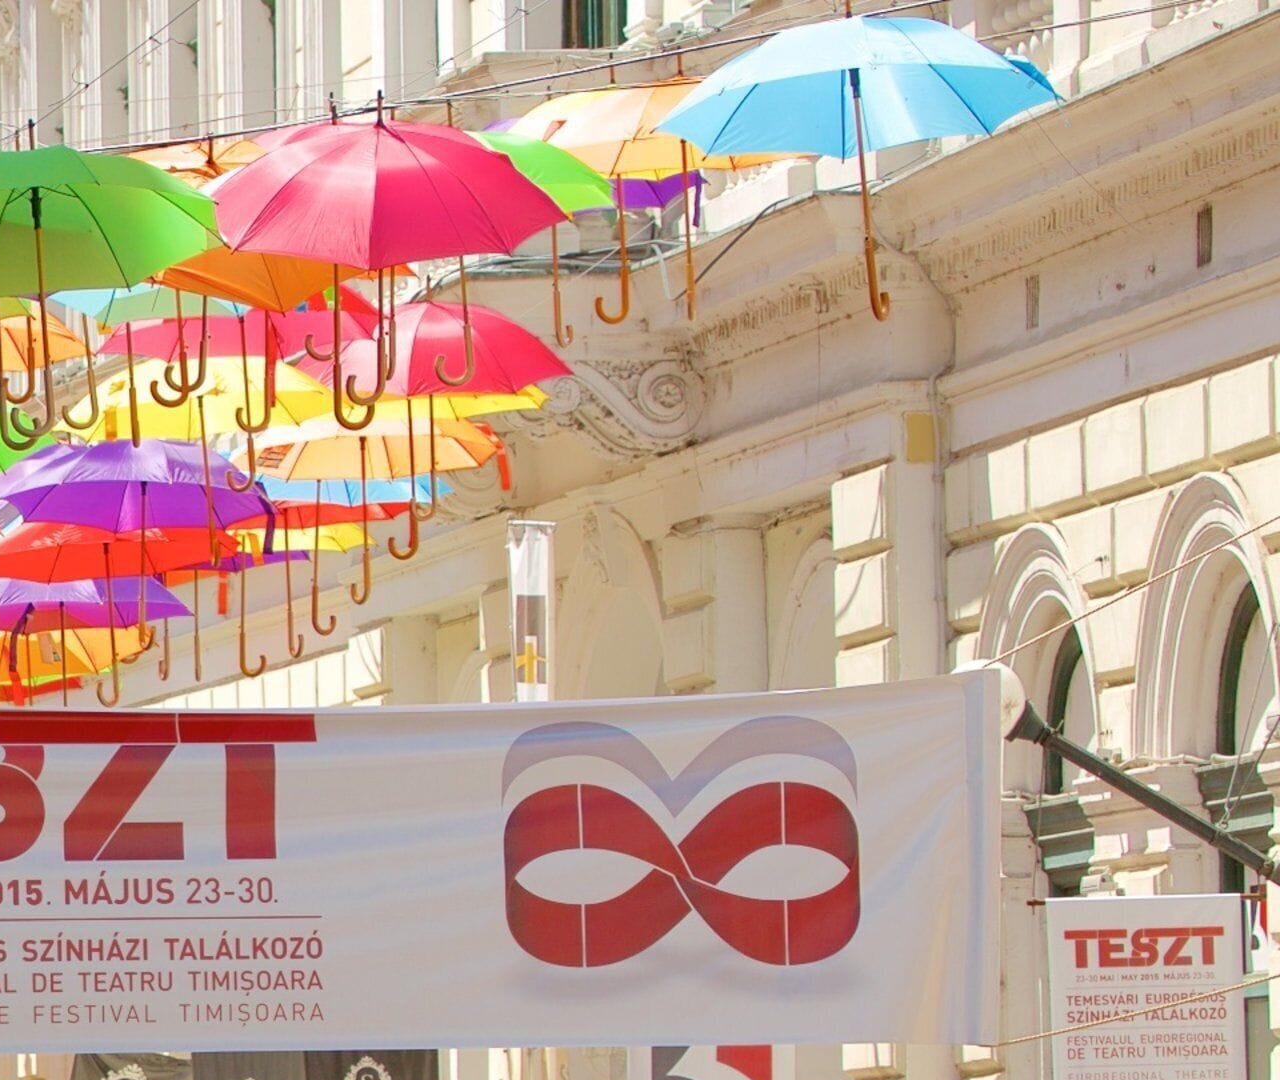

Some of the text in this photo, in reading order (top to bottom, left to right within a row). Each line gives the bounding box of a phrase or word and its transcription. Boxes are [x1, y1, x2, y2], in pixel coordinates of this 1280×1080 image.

[64, 871, 175, 906] MÁJUS
[186, 876, 278, 905] 23-30.
[22, 932, 148, 962] SZÍNHÁZI
[163, 930, 323, 961] TALÁLKOZÓ
[1064, 927, 1224, 968] TESZT
[31, 973, 64, 993] DE
[77, 972, 173, 992] TEATRU
[187, 970, 324, 998] TIMIȘOARA
[1067, 992, 1138, 1006] TEMESVÁRI
[33, 1004, 157, 1025] FESTIVAL
[179, 1002, 325, 1027] TIMIȘOARA
[1067, 1033, 1227, 1046] FESTIVALUL EUROREGIONAL
[1068, 1045, 1227, 1060] DE TEATRU TIMIȘOARA
[1175, 1069, 1229, 1079] THEATRE
